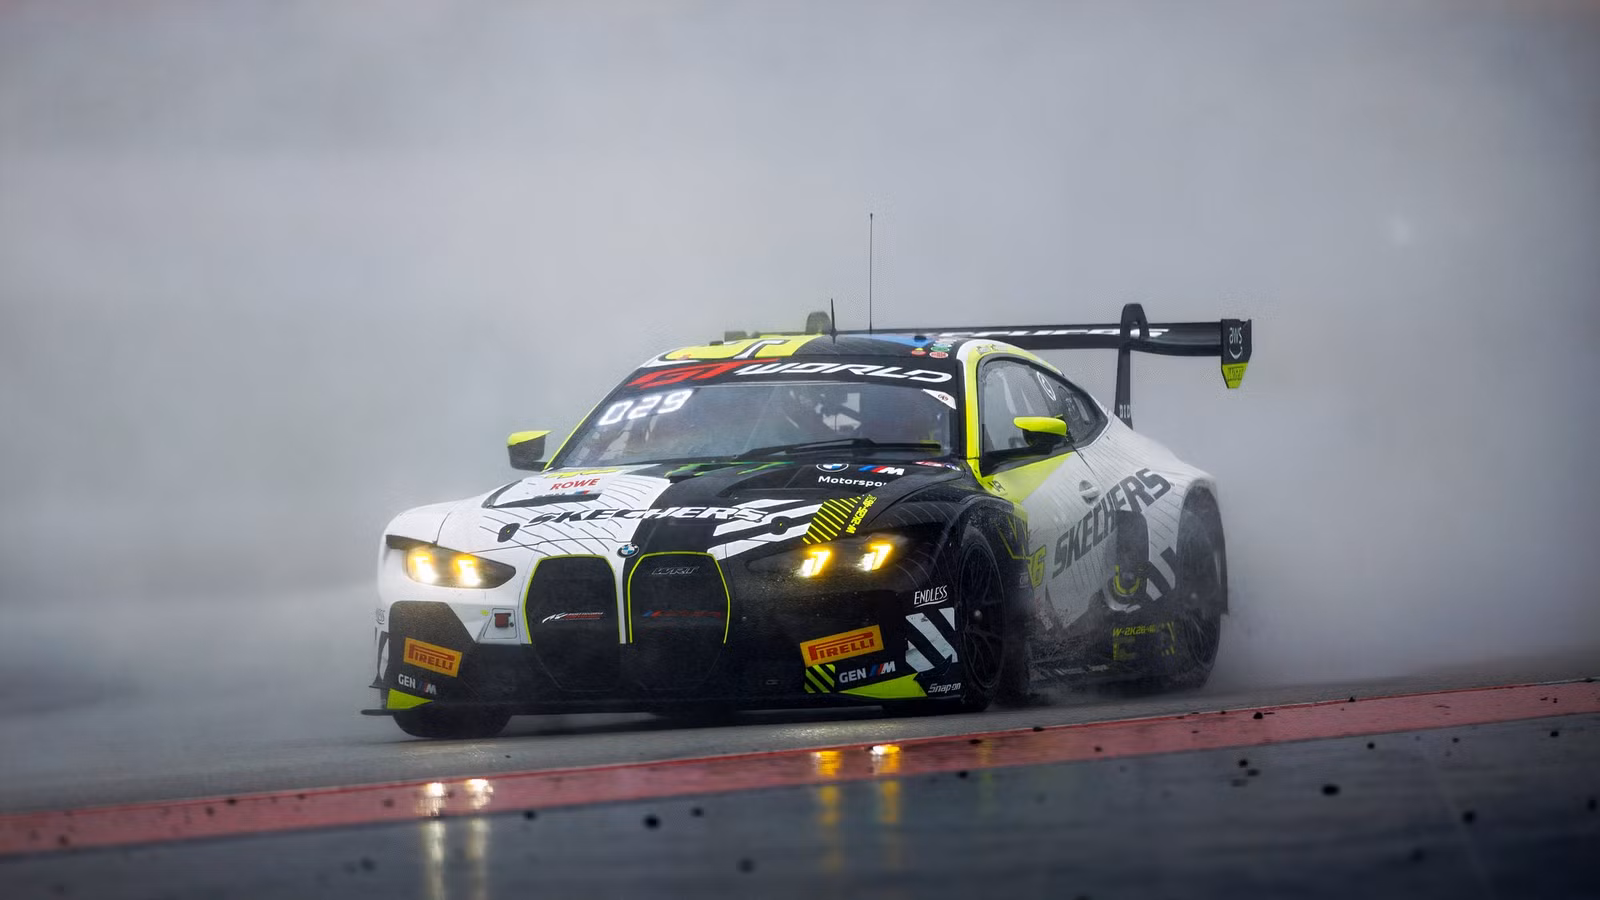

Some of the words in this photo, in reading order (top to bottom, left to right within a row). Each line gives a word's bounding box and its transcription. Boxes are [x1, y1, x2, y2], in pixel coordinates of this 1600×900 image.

[1229, 327, 1243, 344] aws
[625, 358, 780, 389] GT
[734, 362, 953, 383] WORLD
[598, 388, 695, 426] 029
[550, 478, 601, 490] ROWE
[524, 506, 769, 528] SKECHERS
[1052, 467, 1172, 579] SKECHERS
[913, 584, 949, 606] ENDLESS
[408, 642, 456, 671] PIRELLI
[808, 631, 875, 662] PIRELLI
[398, 673, 416, 689] GEN
[839, 667, 867, 684] GEN
